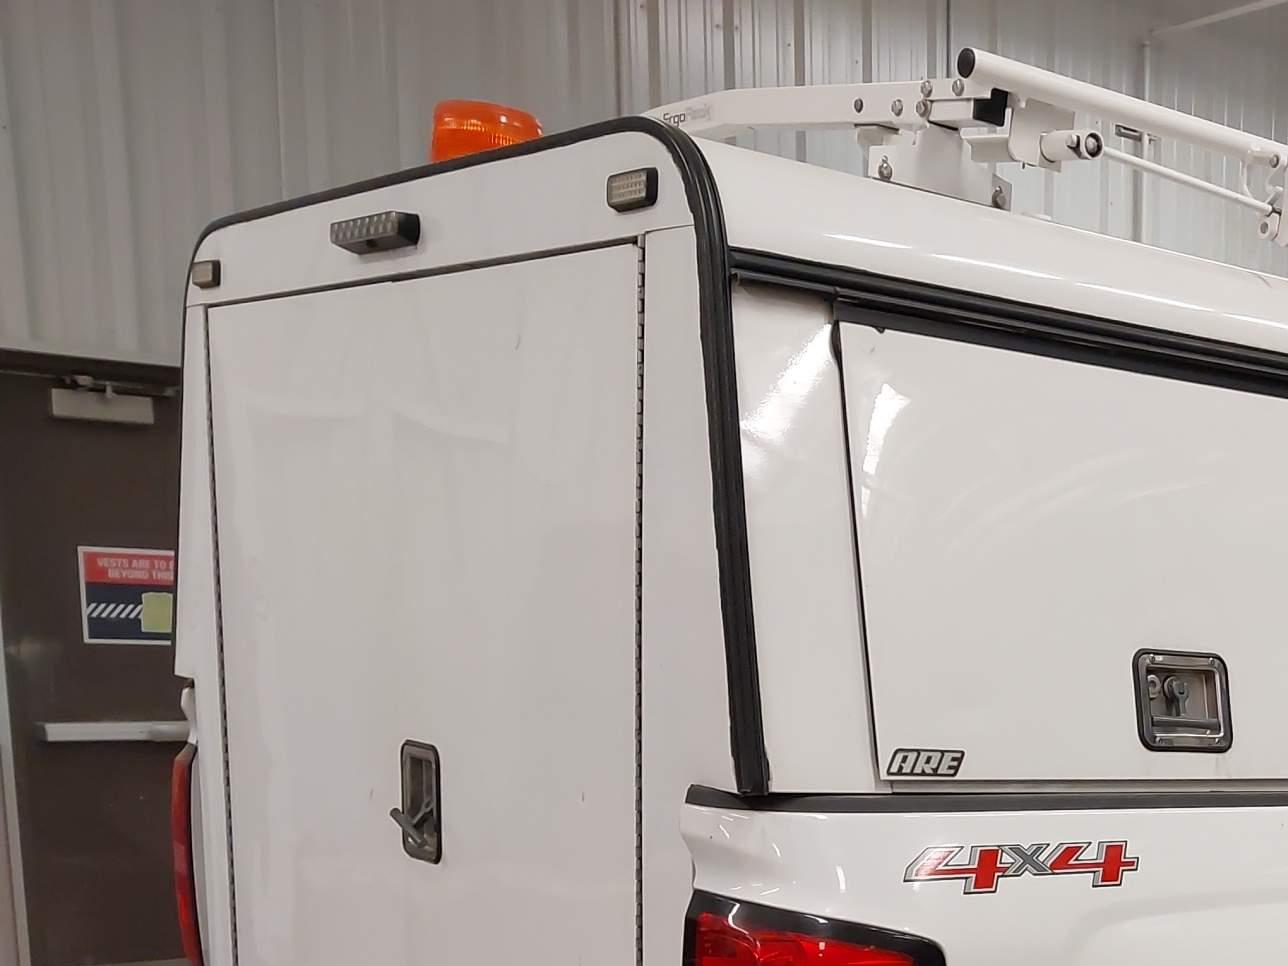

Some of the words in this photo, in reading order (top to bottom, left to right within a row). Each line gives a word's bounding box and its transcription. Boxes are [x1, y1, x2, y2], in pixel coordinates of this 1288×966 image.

[96, 557, 128, 568] VESTS
[131, 559, 150, 569] ARE
[153, 560, 167, 570] TO
[107, 568, 149, 579] BEYOND
[887, 748, 965, 777] ARE
